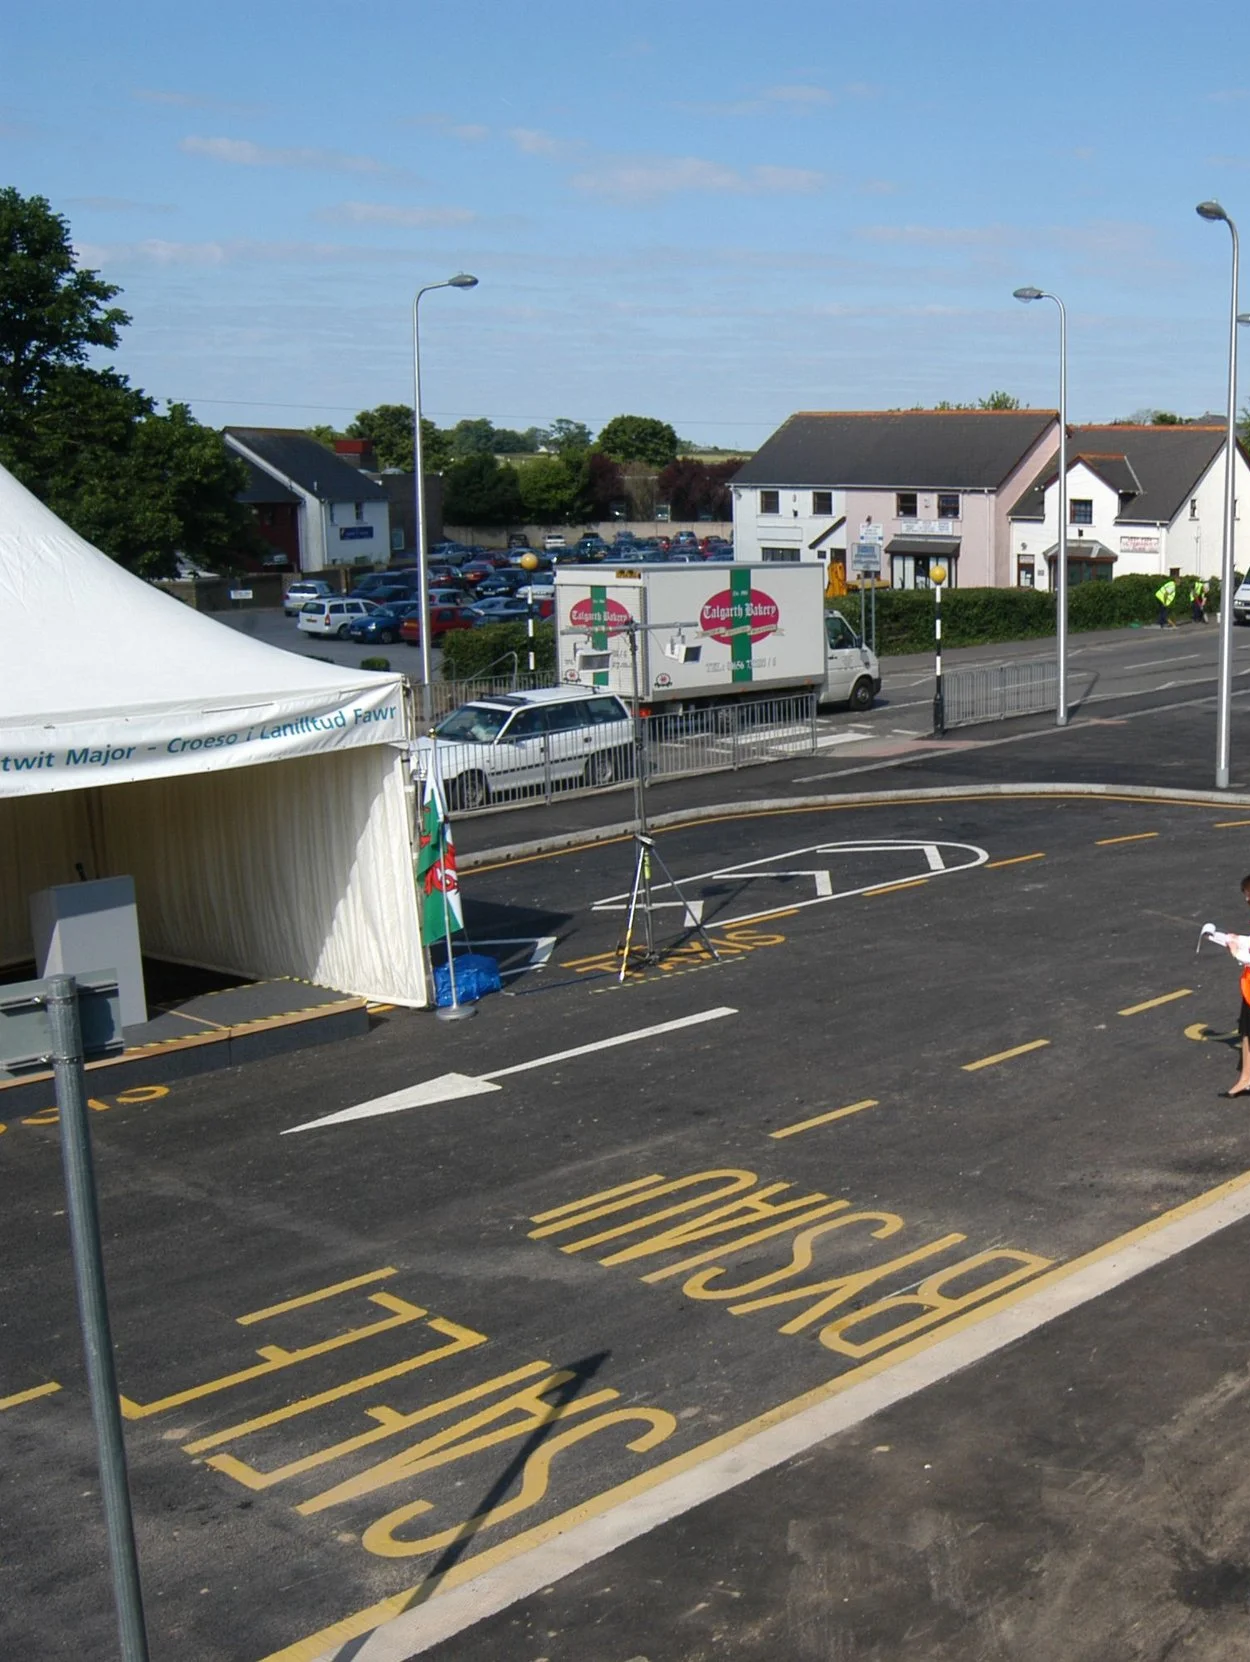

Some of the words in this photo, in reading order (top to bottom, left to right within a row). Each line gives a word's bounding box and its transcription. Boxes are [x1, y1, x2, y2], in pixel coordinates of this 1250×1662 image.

[702, 604, 743, 621] Talgarth
[744, 602, 777, 618] Bakery
[66, 744, 137, 768] Major
[166, 731, 238, 754] Croeso
[246, 727, 254, 743] i
[353, 705, 397, 725] Fawr
